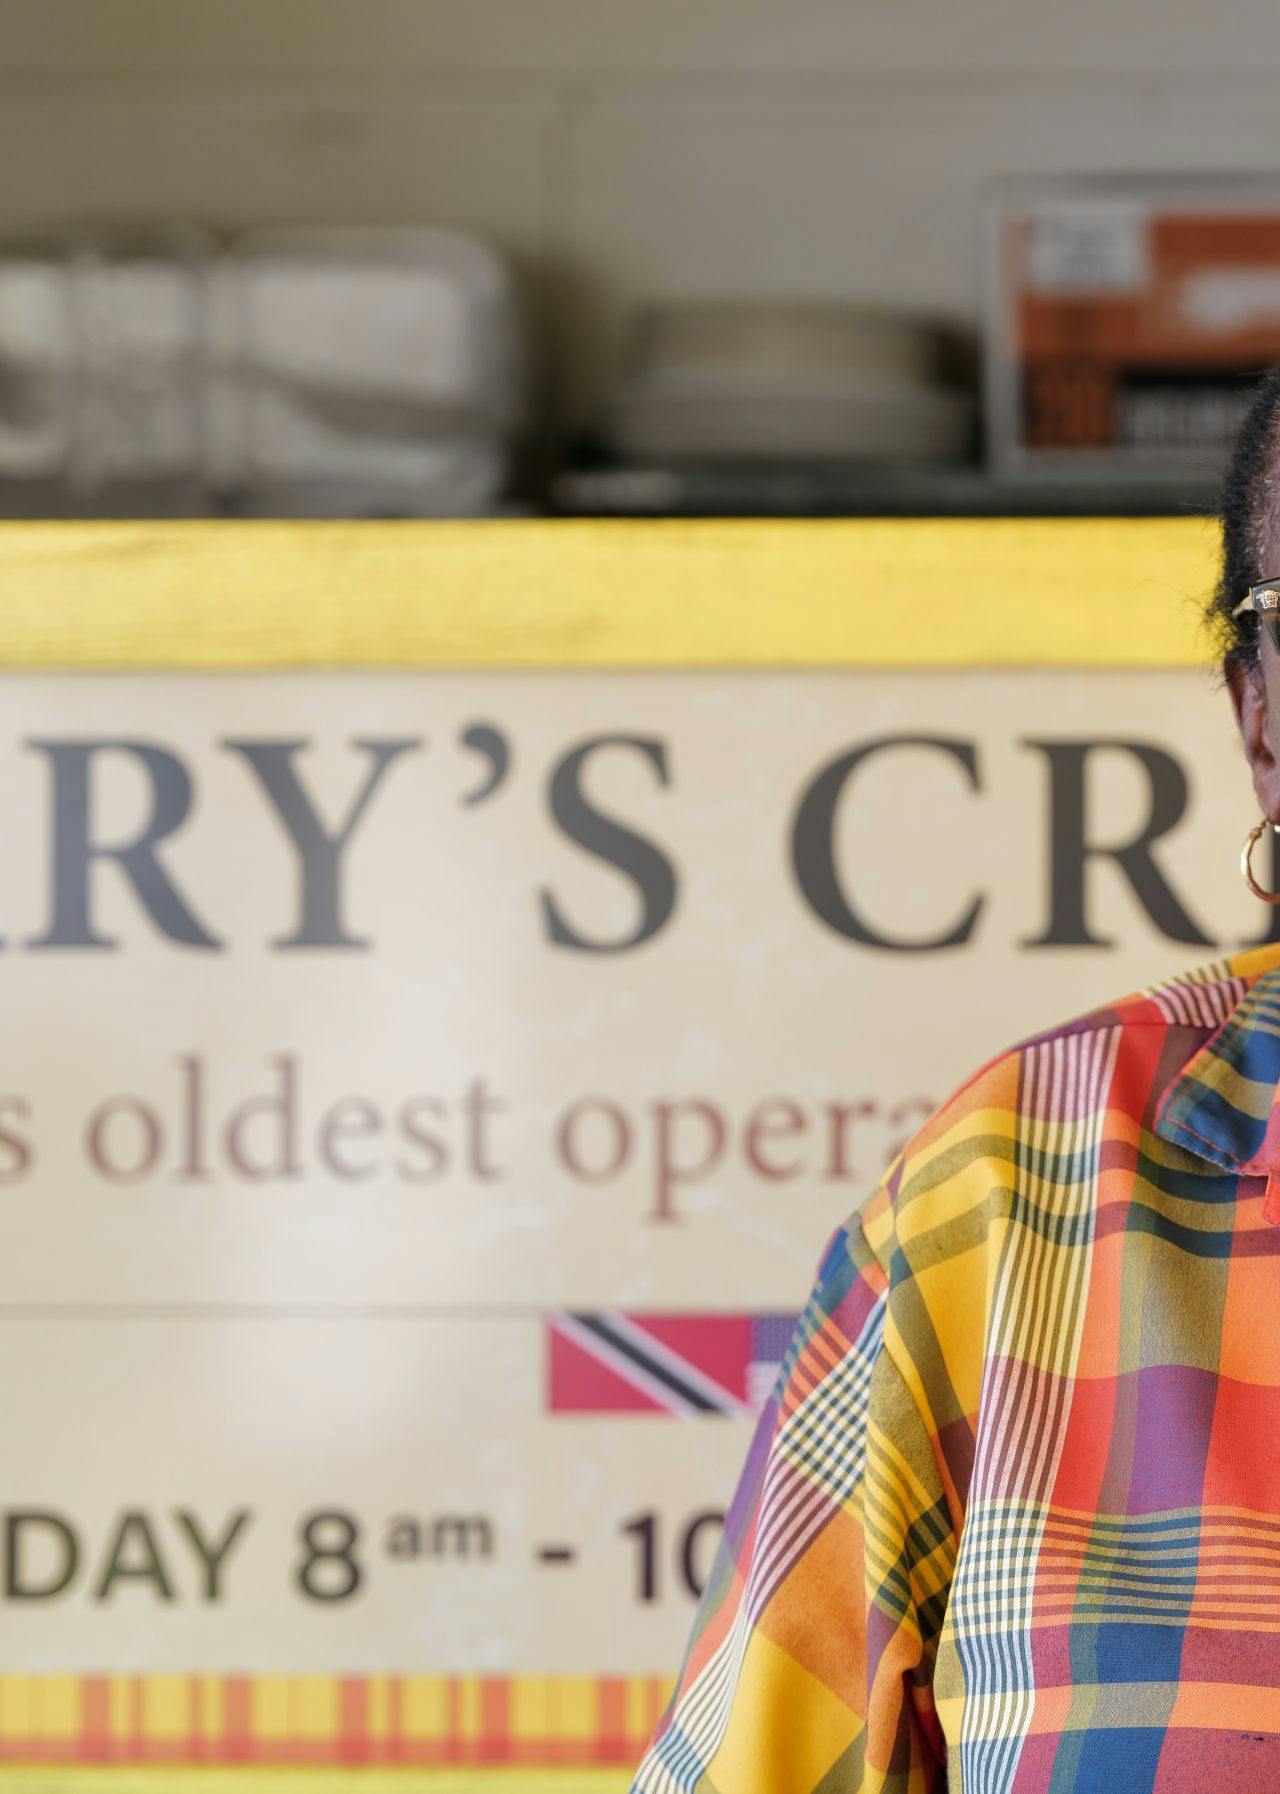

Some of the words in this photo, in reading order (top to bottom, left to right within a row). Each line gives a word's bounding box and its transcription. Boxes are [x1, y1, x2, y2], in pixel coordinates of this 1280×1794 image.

[0, 720, 683, 954] RY’S
[82, 1052, 507, 1187] oldest
[4, 1508, 251, 1602] DAY
